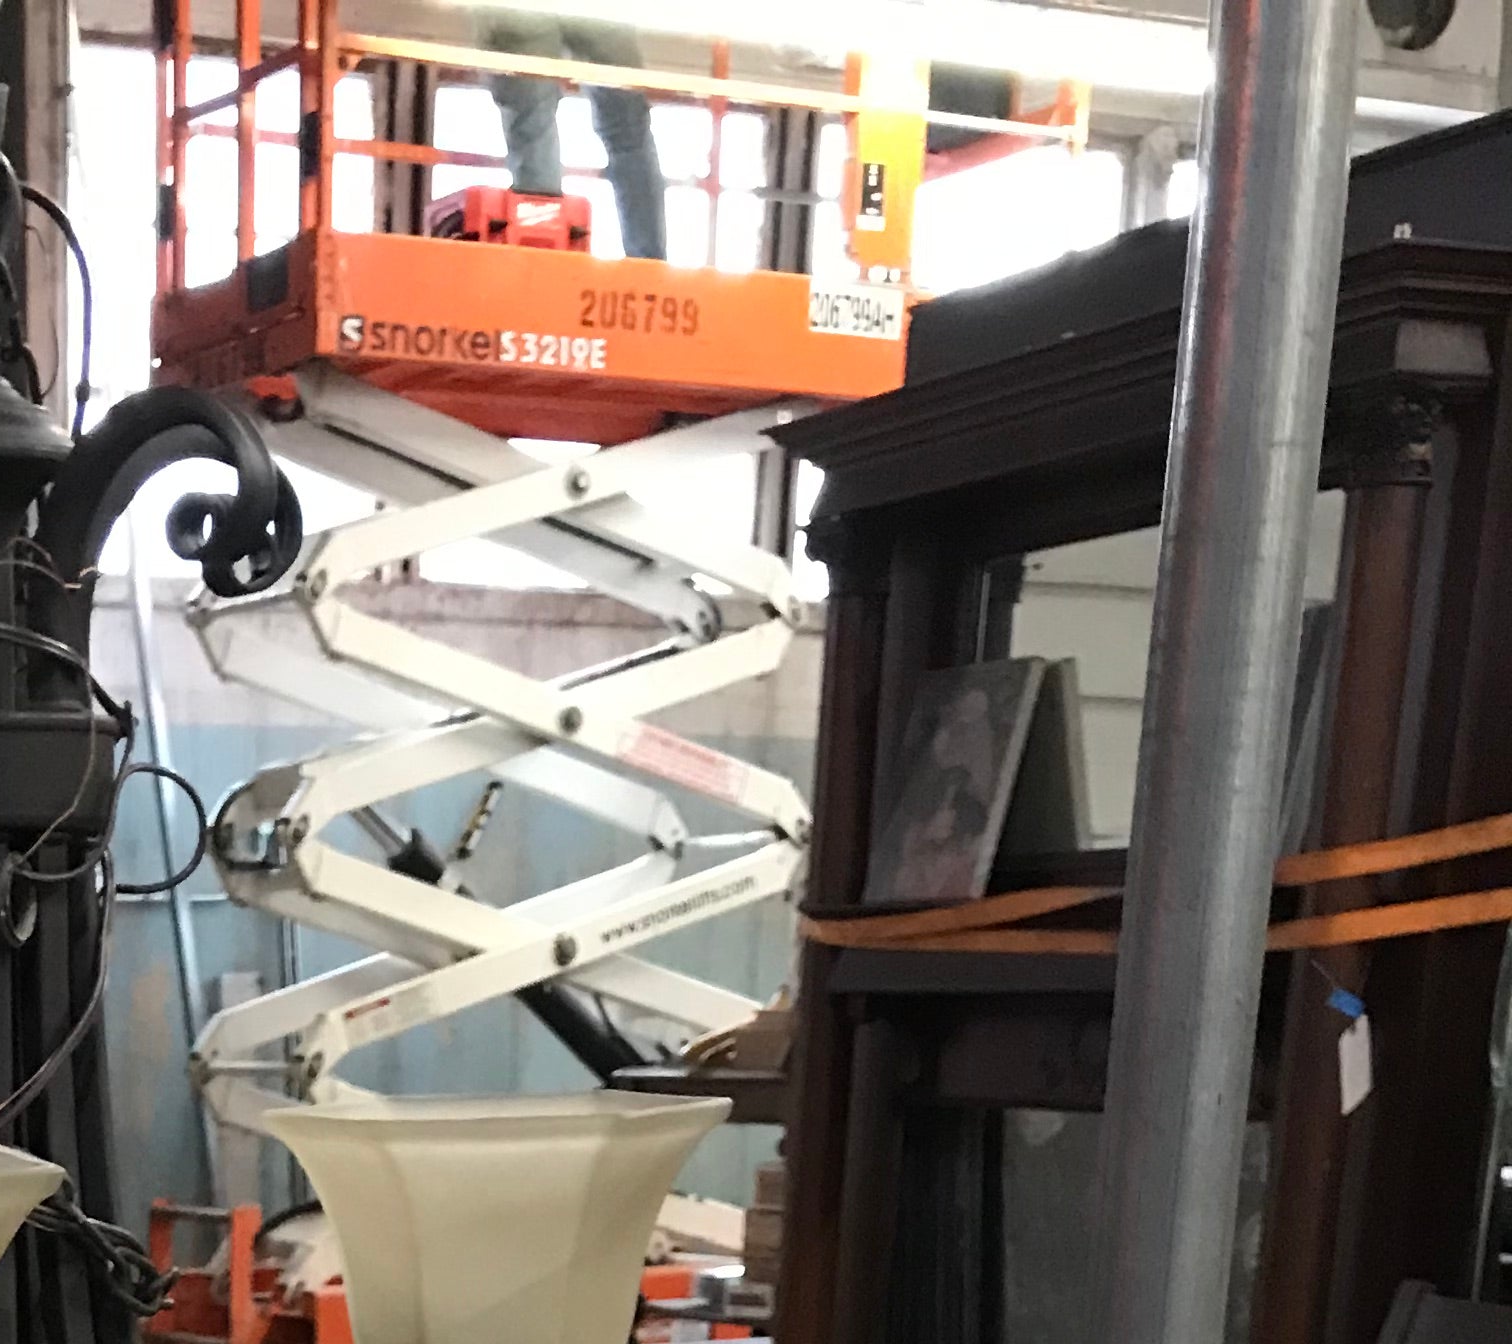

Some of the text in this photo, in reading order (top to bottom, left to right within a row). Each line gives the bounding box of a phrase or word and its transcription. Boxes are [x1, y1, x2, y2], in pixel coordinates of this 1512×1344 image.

[581, 289, 699, 336] 206799
[372, 321, 500, 361] snorkel
[499, 330, 608, 369] S3219E
